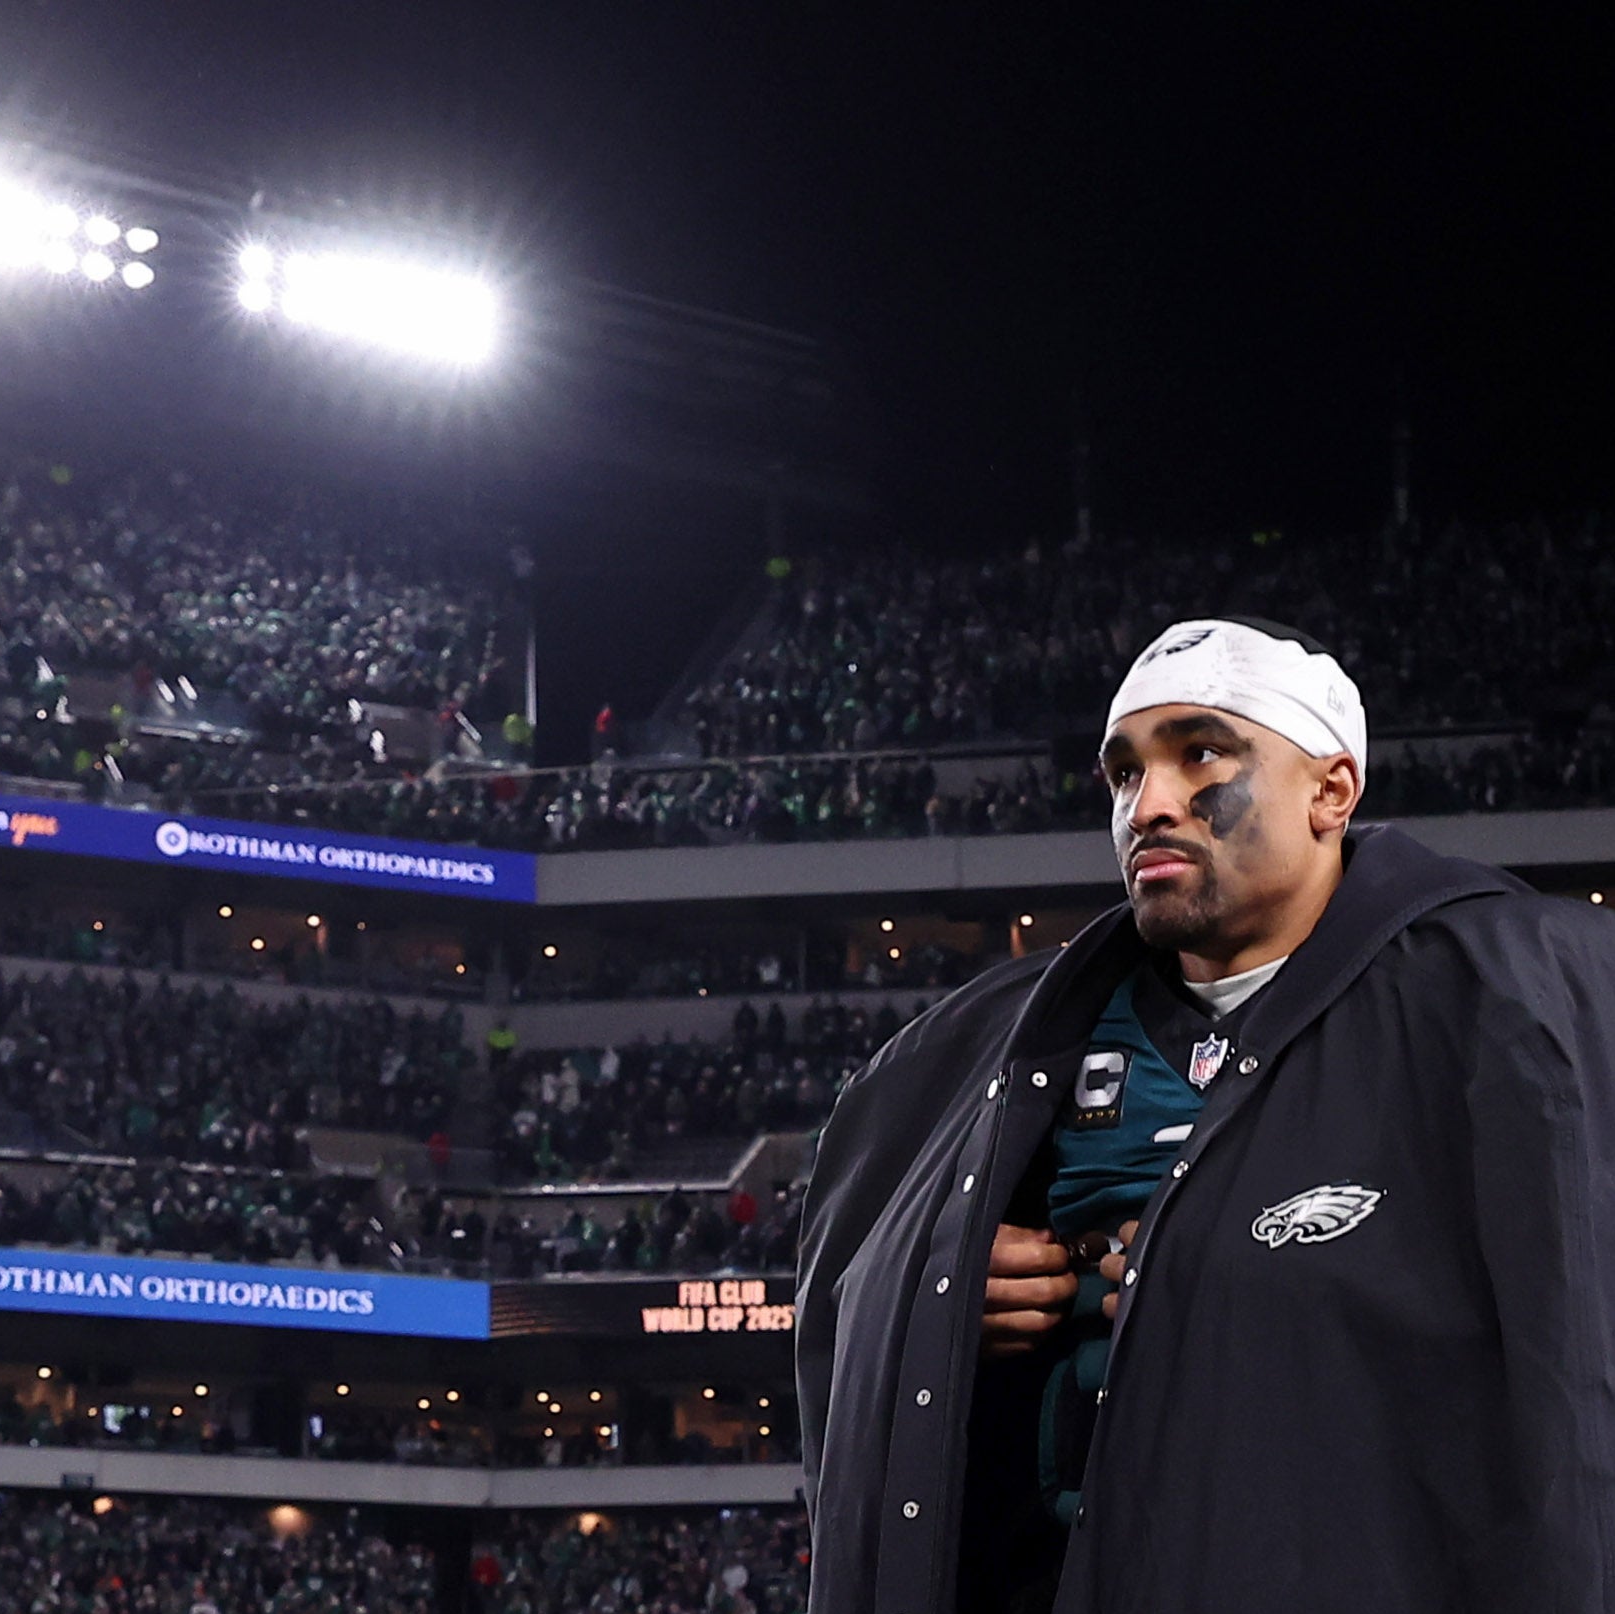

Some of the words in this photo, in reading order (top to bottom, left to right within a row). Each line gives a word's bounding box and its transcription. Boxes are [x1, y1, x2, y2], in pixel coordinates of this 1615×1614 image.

[187, 829, 317, 864] ROTHMAN
[319, 845, 496, 885] ORTHOPAEDICS
[1074, 1051, 1125, 1109] C
[140, 1277, 375, 1315] ORTHOPAEDICS
